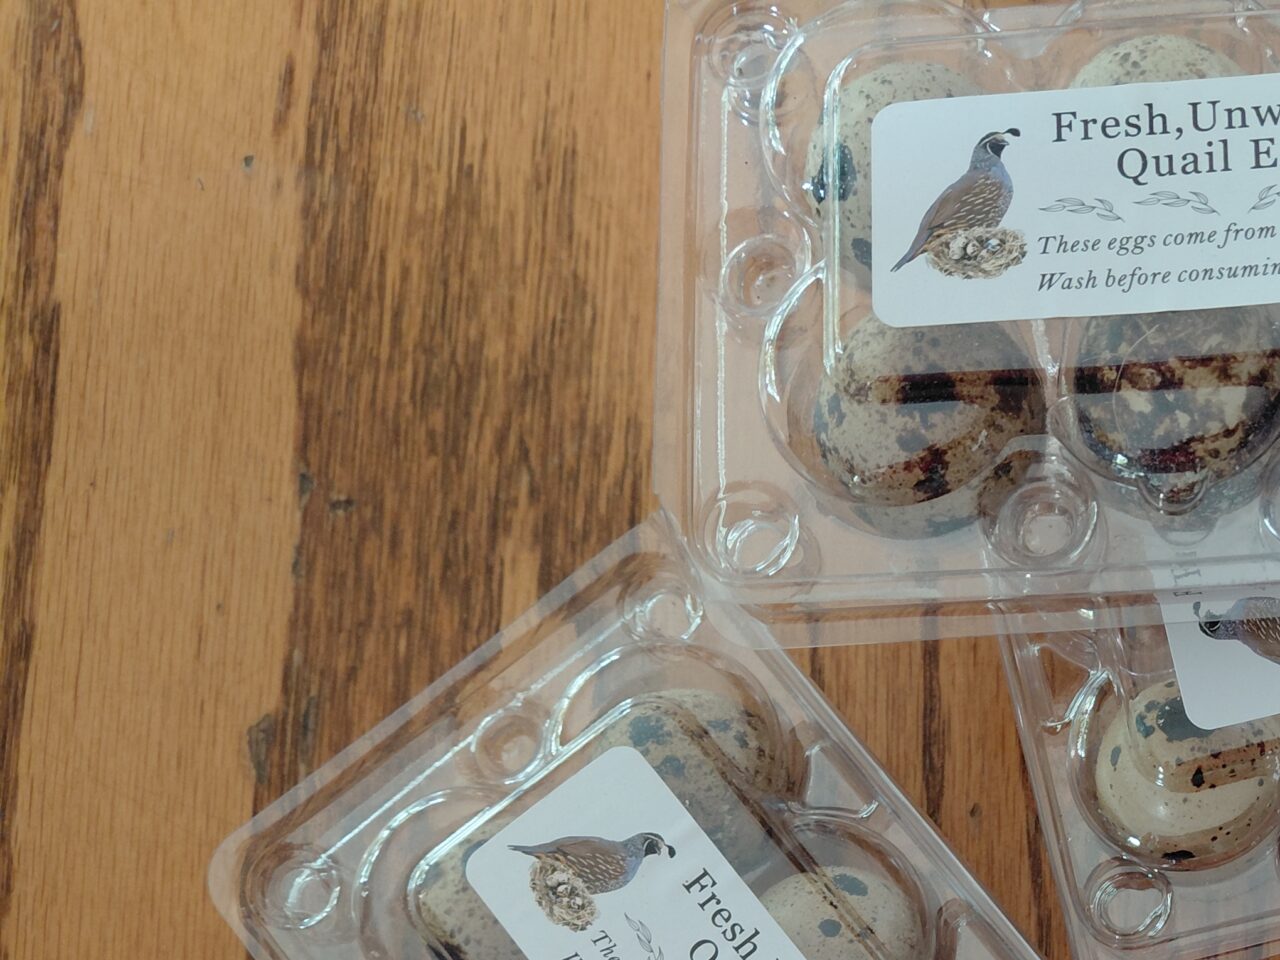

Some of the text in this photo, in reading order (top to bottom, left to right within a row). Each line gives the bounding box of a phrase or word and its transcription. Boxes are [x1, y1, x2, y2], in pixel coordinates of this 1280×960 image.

[1116, 137, 1233, 187] Quail
[1036, 233, 1102, 256] These
[1106, 233, 1157, 257] eggs
[1161, 229, 1218, 248] come
[1215, 221, 1278, 250] from
[1037, 268, 1098, 292] Wash
[1104, 265, 1172, 294] before
